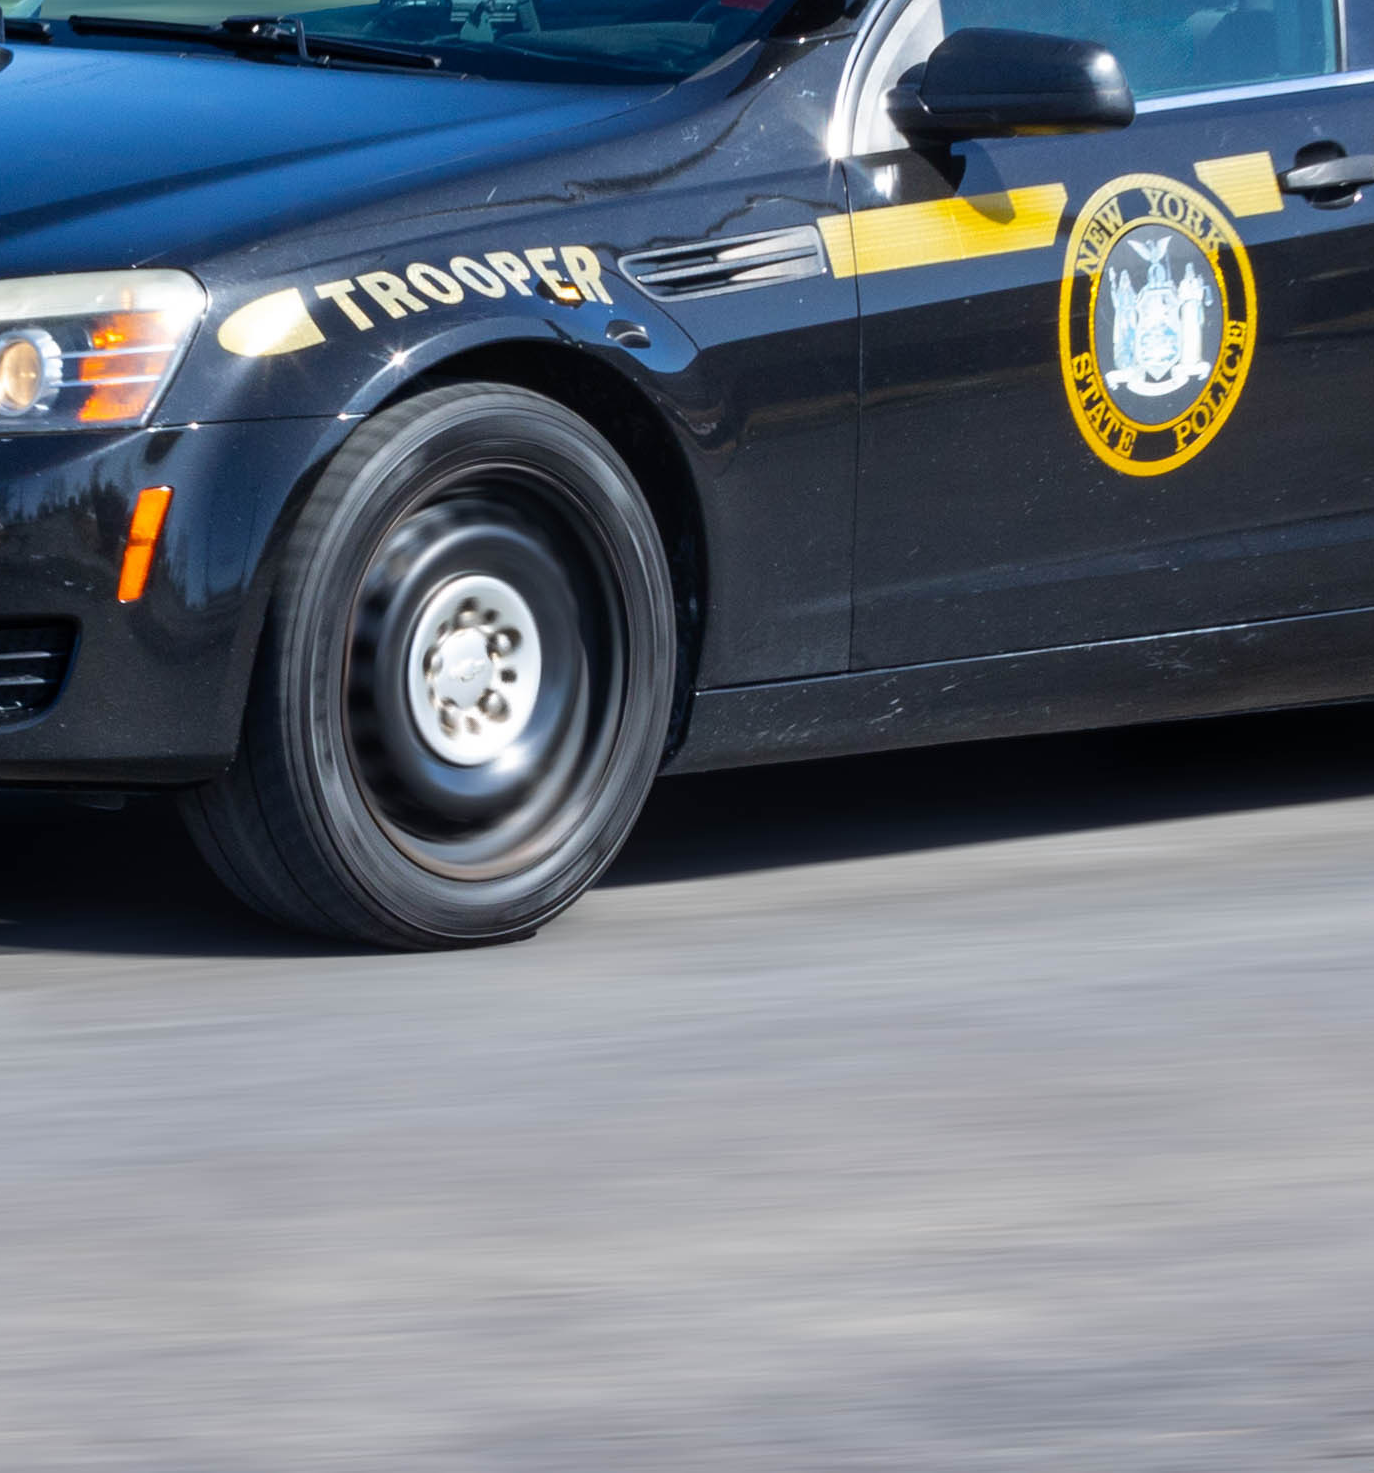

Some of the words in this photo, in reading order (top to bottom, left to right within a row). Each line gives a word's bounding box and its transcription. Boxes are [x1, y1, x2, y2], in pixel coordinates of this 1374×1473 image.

[1076, 196, 1124, 277] NEW
[1142, 187, 1229, 254] YORK
[315, 245, 613, 331] TROOPER
[1071, 351, 1137, 458] STATE
[1173, 320, 1247, 453] POLICE
